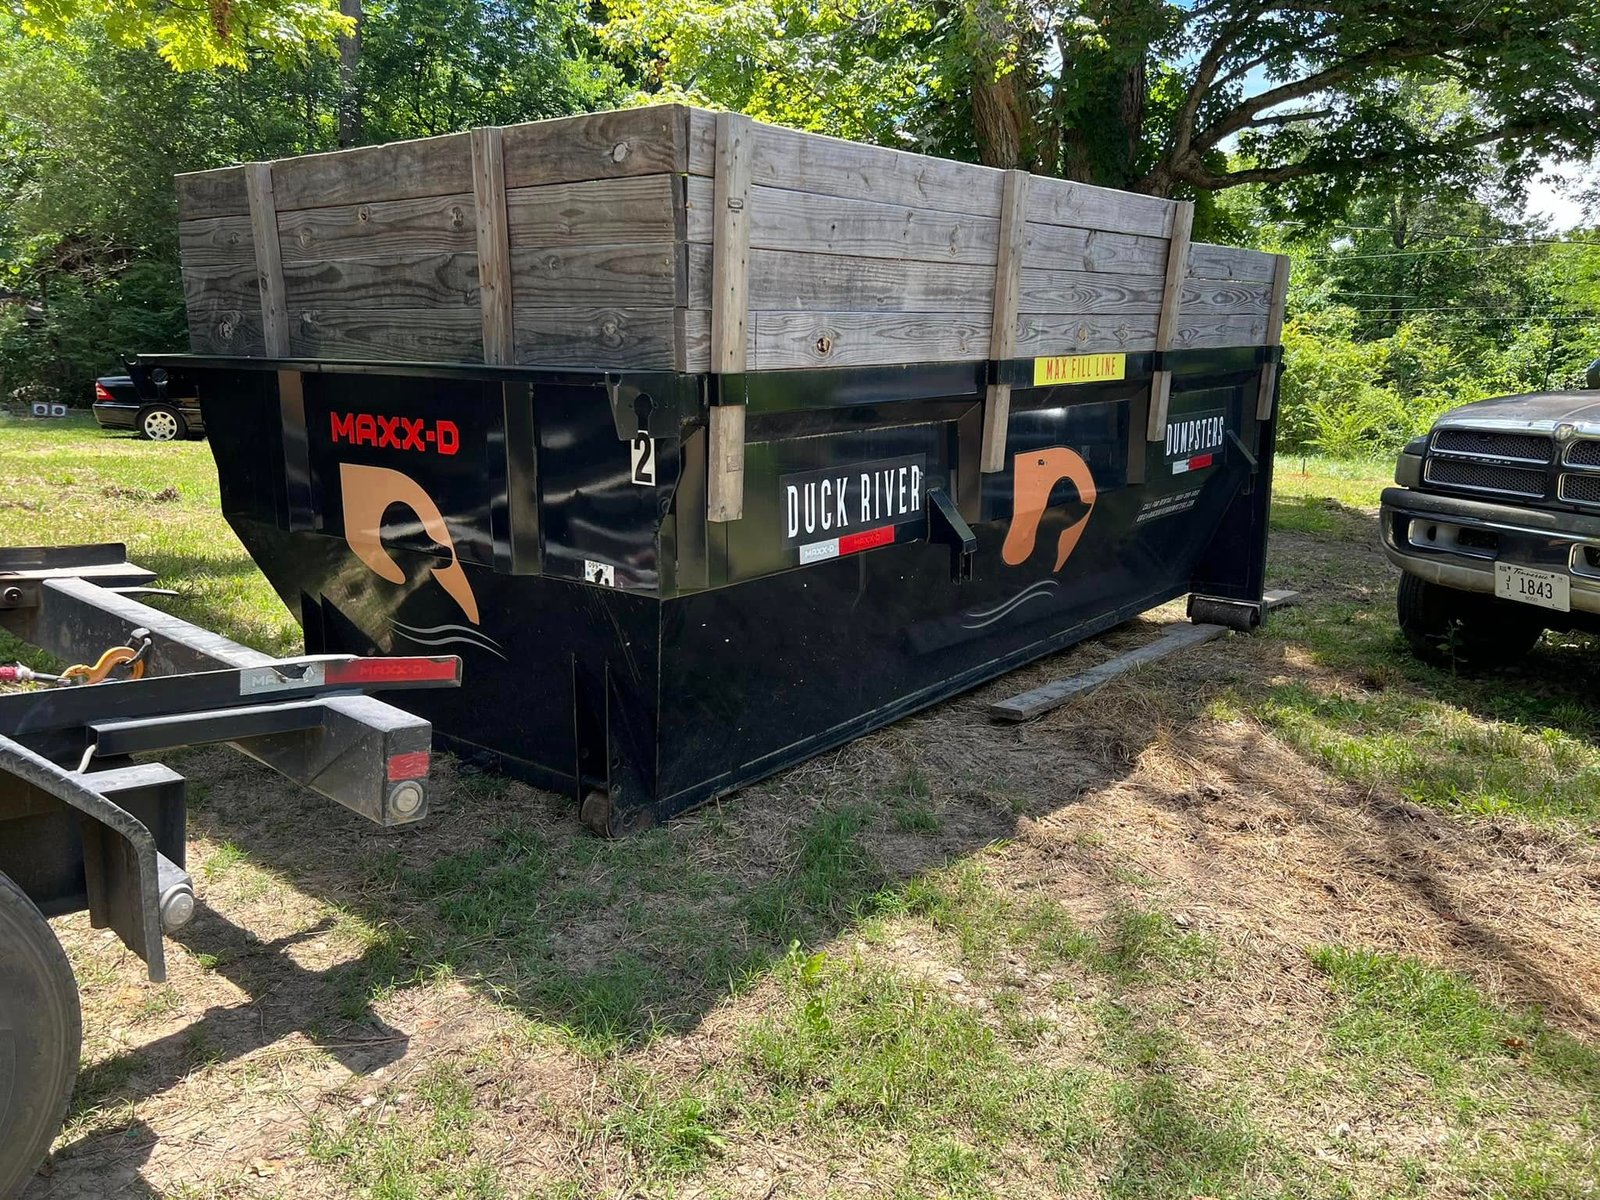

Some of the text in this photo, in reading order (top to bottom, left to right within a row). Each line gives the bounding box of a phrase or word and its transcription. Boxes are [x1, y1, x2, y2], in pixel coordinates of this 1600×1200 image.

[1046, 357, 1116, 379] MAX FILL LINE
[330, 411, 459, 455] MAXX-D
[1165, 416, 1225, 456] DUMPSTERS
[634, 431, 653, 483] 2
[787, 464, 921, 539] DUCK RIVER
[804, 544, 835, 559] MAXX-D
[1513, 567, 1549, 580] Tennessee
[1519, 578, 1553, 599] 1843
[360, 664, 422, 677] MAXX-D
